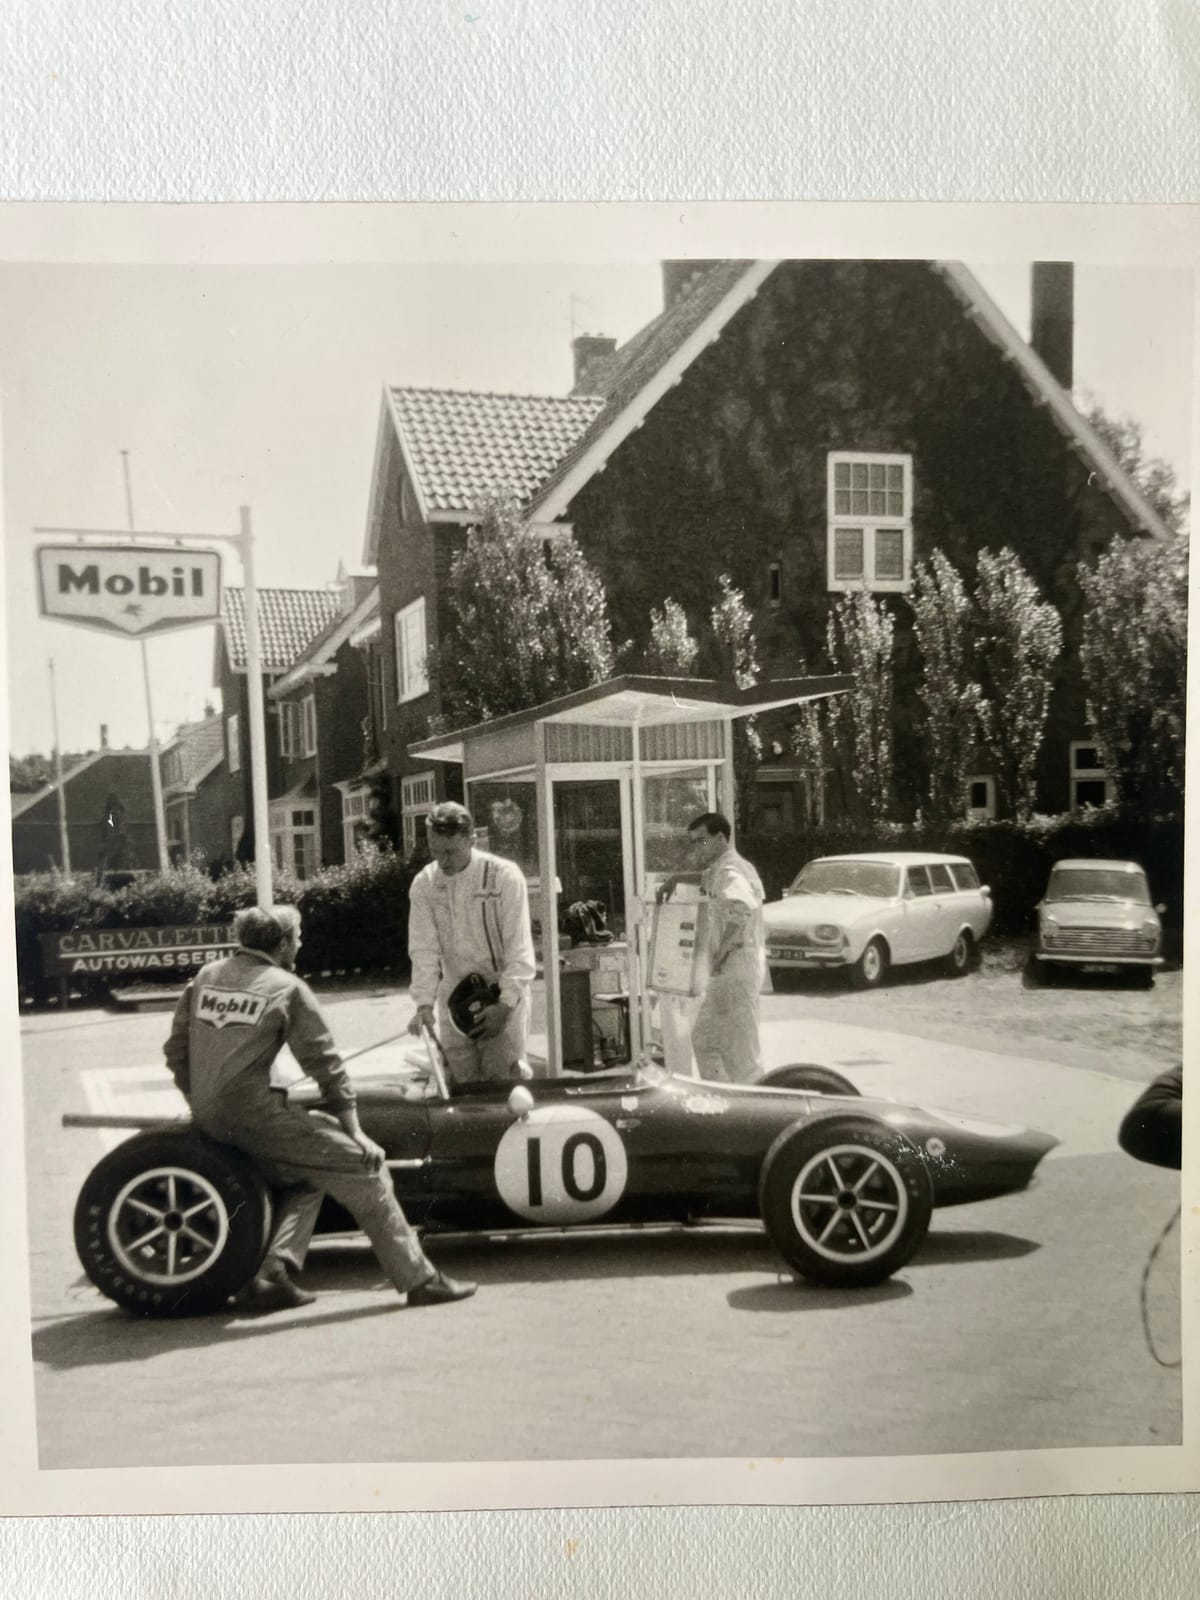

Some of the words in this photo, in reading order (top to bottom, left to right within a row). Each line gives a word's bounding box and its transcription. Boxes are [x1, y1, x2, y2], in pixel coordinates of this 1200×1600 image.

[58, 564, 204, 597] Mobil
[200, 995, 258, 1015] Mobil
[527, 1132, 607, 1206] 10
